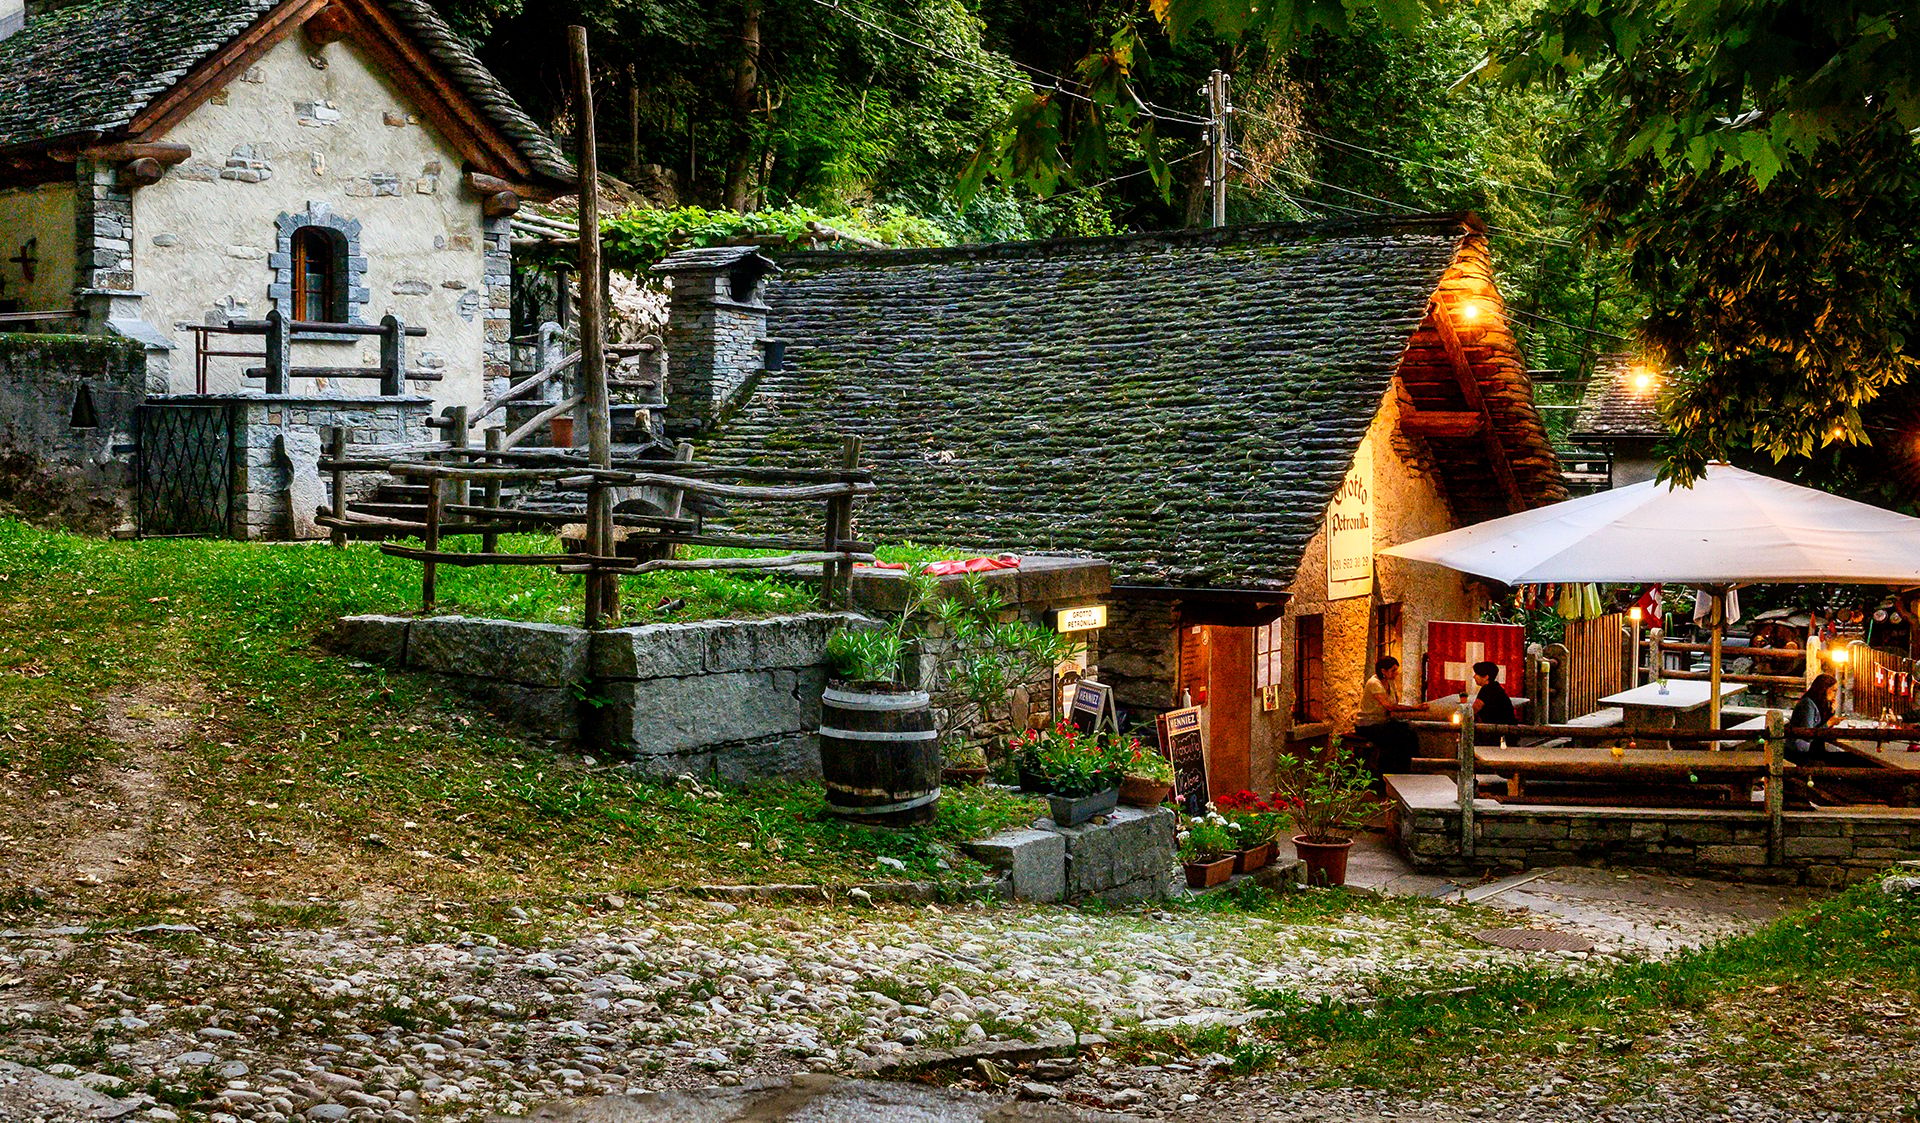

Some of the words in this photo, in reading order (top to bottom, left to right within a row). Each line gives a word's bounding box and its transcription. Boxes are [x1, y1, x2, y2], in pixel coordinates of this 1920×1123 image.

[1332, 512, 1369, 536] Petronilla
[1072, 609, 1093, 618] GROTTO
[1067, 619, 1097, 629] PETRONILLA
[1079, 691, 1099, 705] HENNIEZ
[1169, 714, 1196, 728] HENNIEZ
